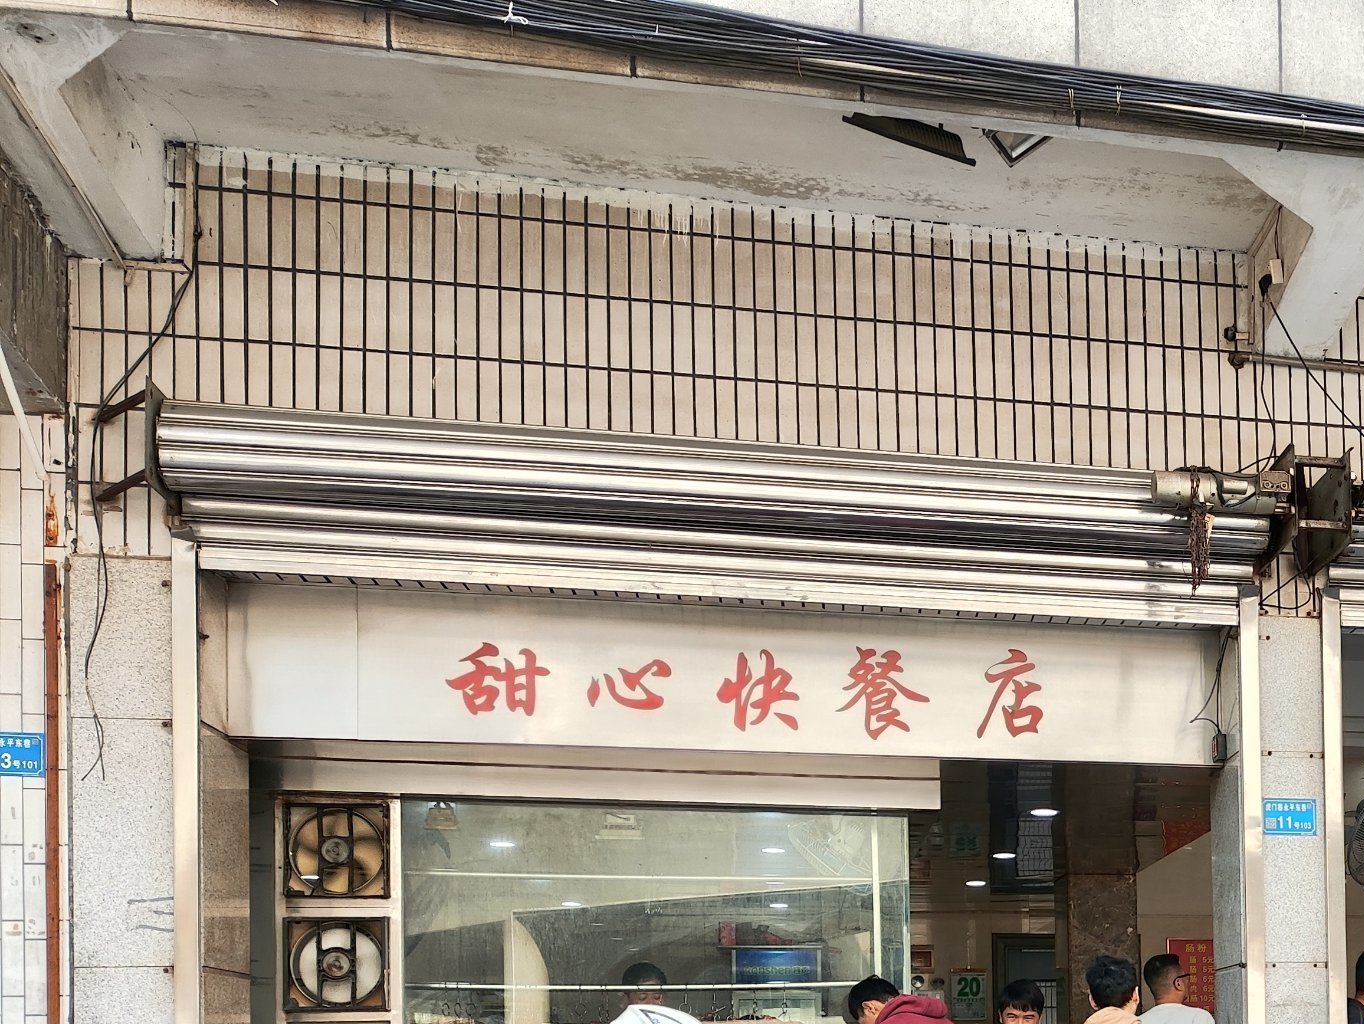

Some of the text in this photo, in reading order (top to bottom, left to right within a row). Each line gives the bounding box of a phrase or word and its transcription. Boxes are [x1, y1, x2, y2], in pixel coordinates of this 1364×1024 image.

[445, 641, 1044, 740] 甜心快餐店
[1277, 815, 1312, 830] 11号103
[1185, 943, 1207, 953] 肠粉
[956, 976, 981, 998] 20
